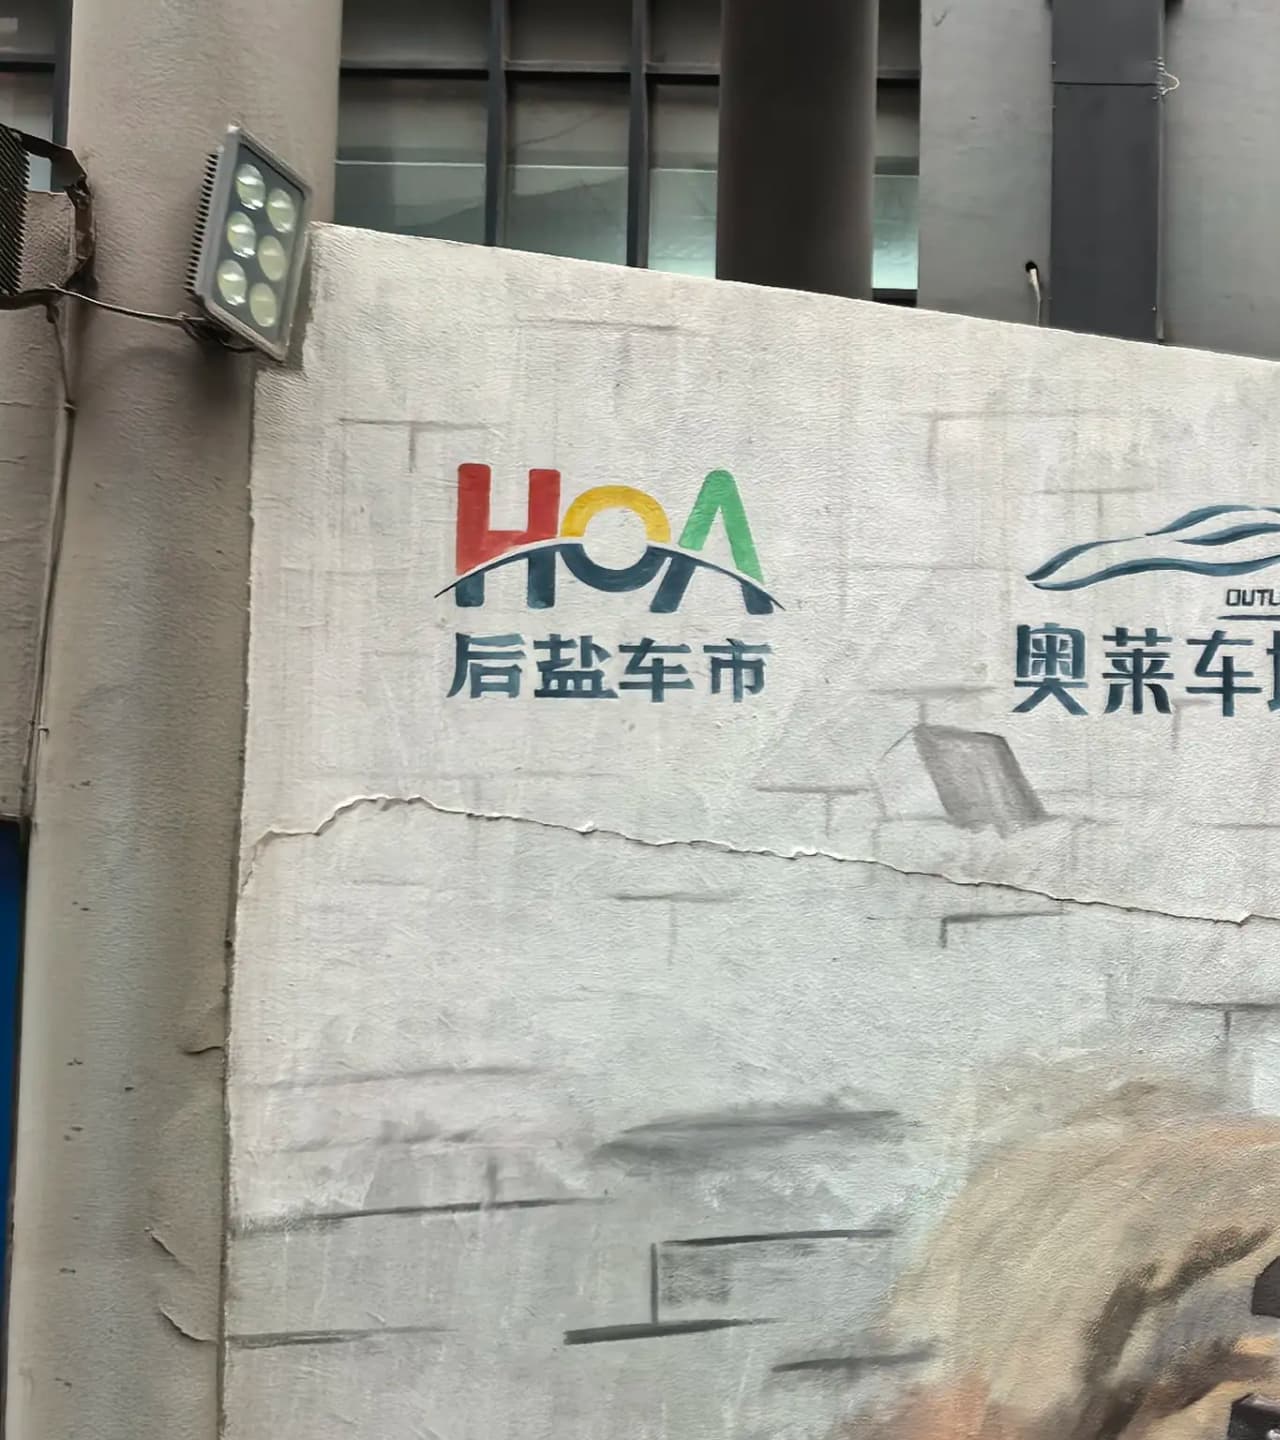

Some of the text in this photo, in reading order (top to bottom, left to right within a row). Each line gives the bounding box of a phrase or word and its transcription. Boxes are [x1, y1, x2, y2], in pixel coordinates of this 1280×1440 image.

[453, 462, 774, 615] HOA
[445, 631, 772, 704] 后盐车市
